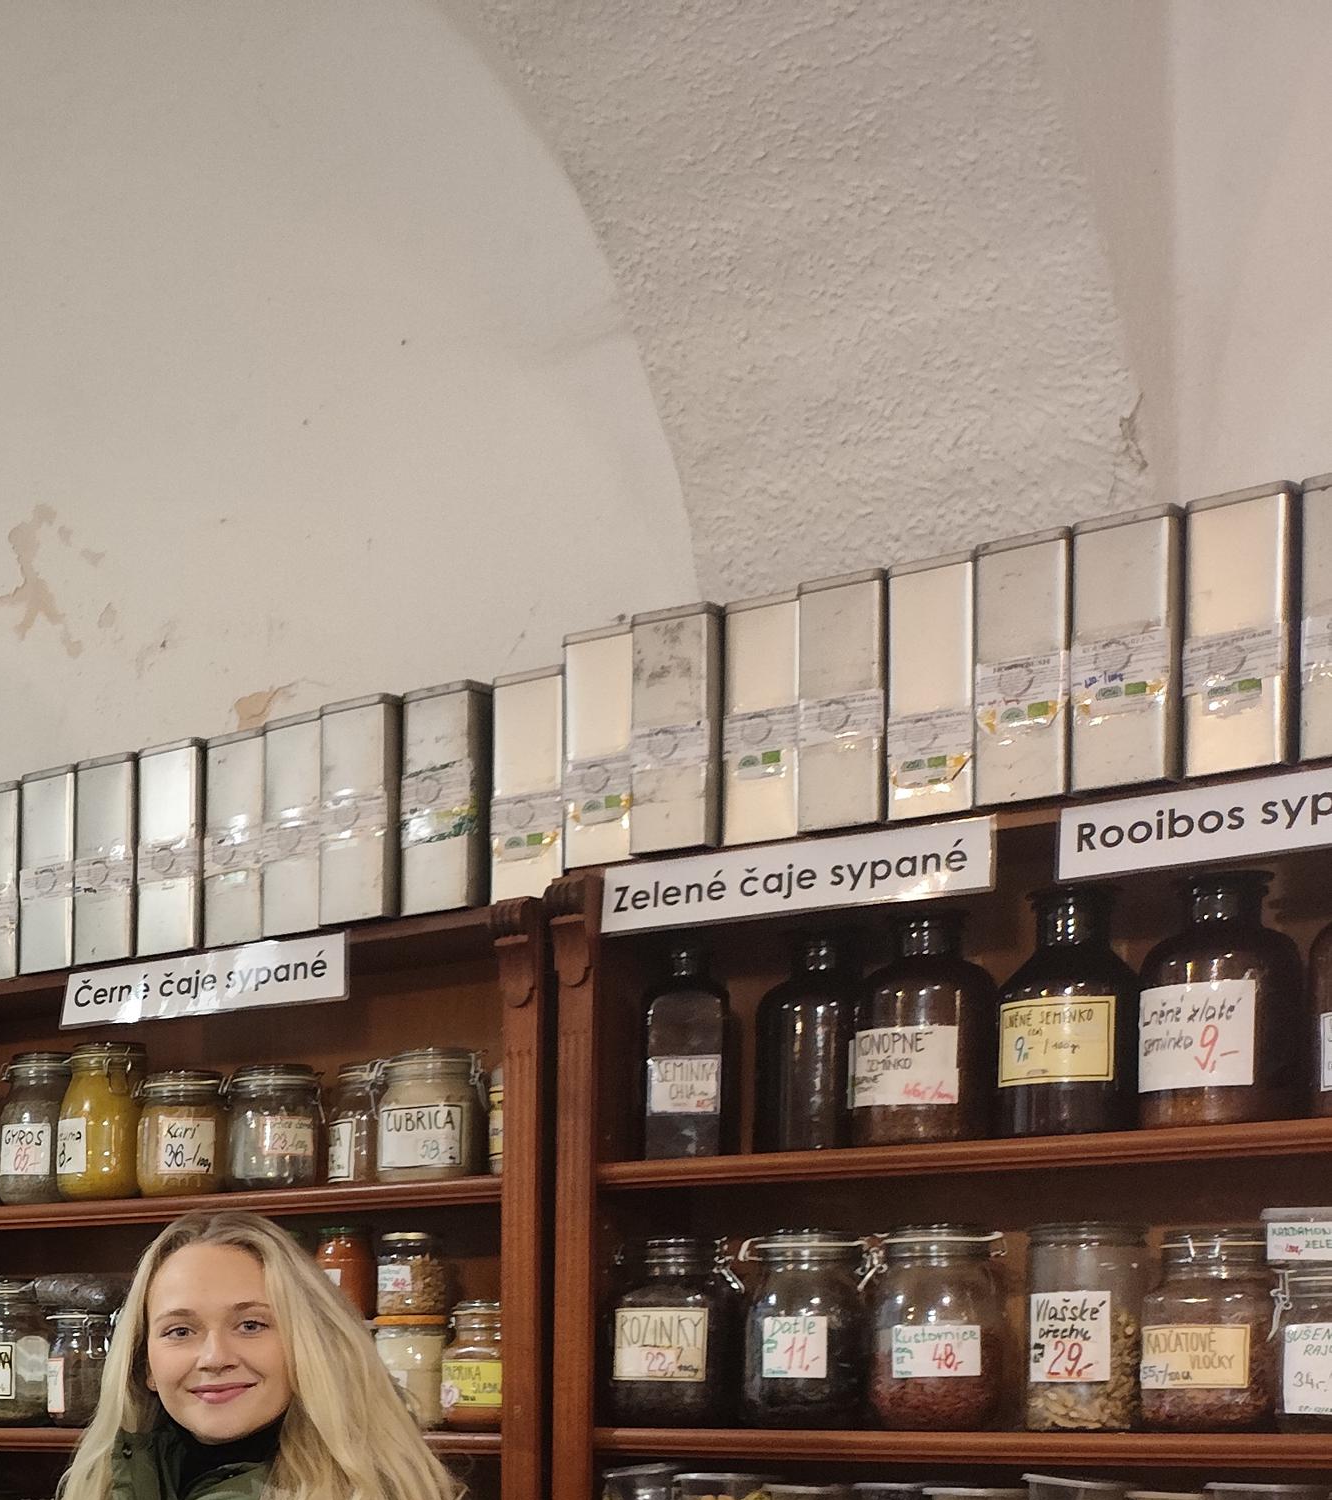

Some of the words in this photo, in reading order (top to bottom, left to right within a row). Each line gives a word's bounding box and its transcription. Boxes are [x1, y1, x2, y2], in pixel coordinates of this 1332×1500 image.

[1075, 803, 1246, 853] Rooibos
[614, 868, 727, 913] Zelené
[739, 863, 817, 900] čaje
[829, 838, 969, 890] sypané
[74, 973, 149, 1008] Černé
[159, 970, 217, 1000] čaje
[226, 950, 328, 993] sypané
[4, 1129, 45, 1146] GYROS
[1036, 1297, 1106, 1323] Vlašské
[620, 1315, 704, 1348] ROZINKY
[1189, 1353, 1235, 1371] VLOČKY
